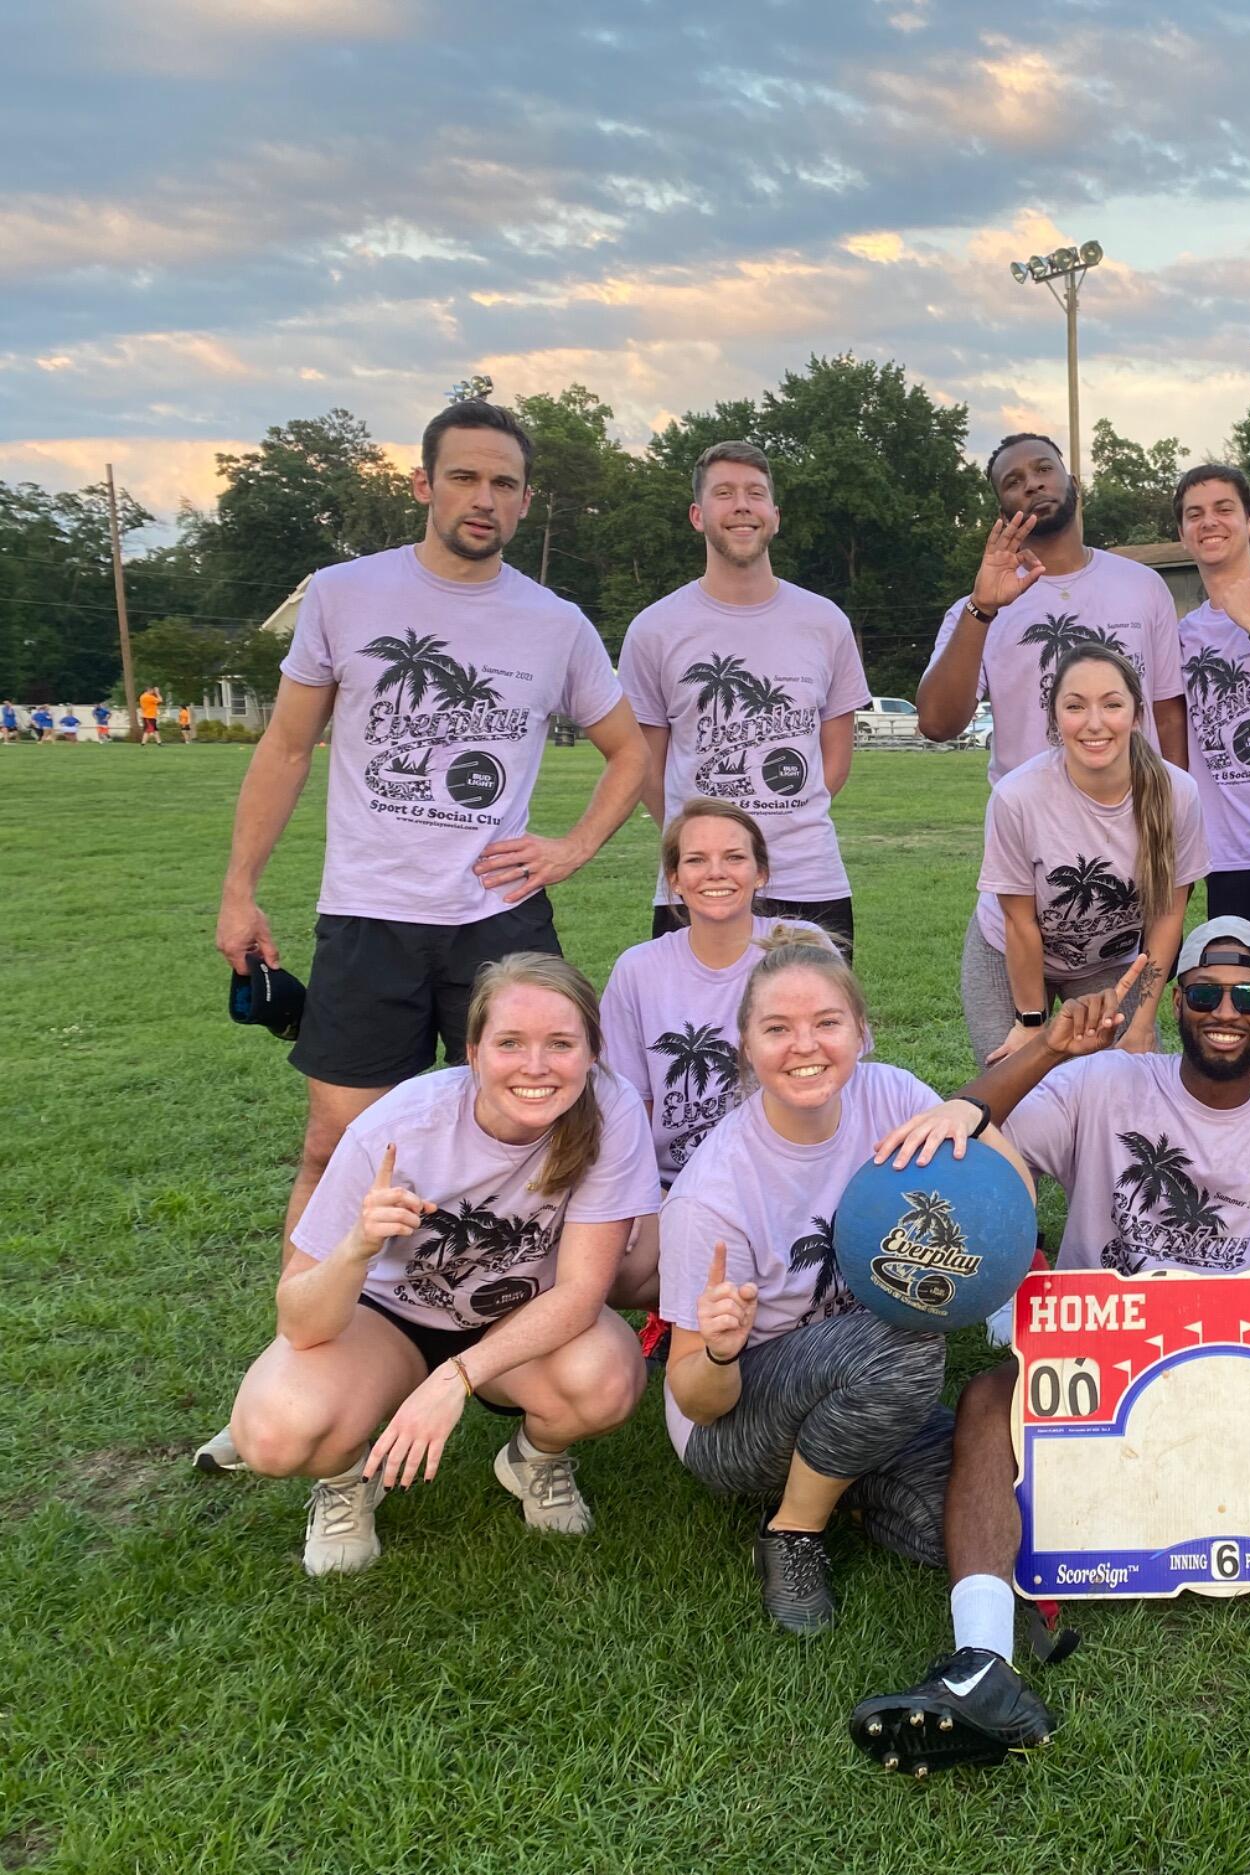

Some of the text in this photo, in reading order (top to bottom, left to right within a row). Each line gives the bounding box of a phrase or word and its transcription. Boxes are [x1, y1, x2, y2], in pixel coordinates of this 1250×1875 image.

[481, 664, 513, 677] Summer
[467, 779, 495, 788] LIGHT
[472, 772, 492, 781] BUD
[740, 799, 750, 809] &
[753, 799, 790, 809] Social
[369, 799, 504, 826] Sport & Social Clu
[1213, 1192, 1247, 1207] Summer
[880, 1227, 984, 1276] Everplay
[1029, 1292, 1147, 1333] HOME
[1169, 1553, 1208, 1571] INNING
[1215, 1543, 1240, 1579] 6
